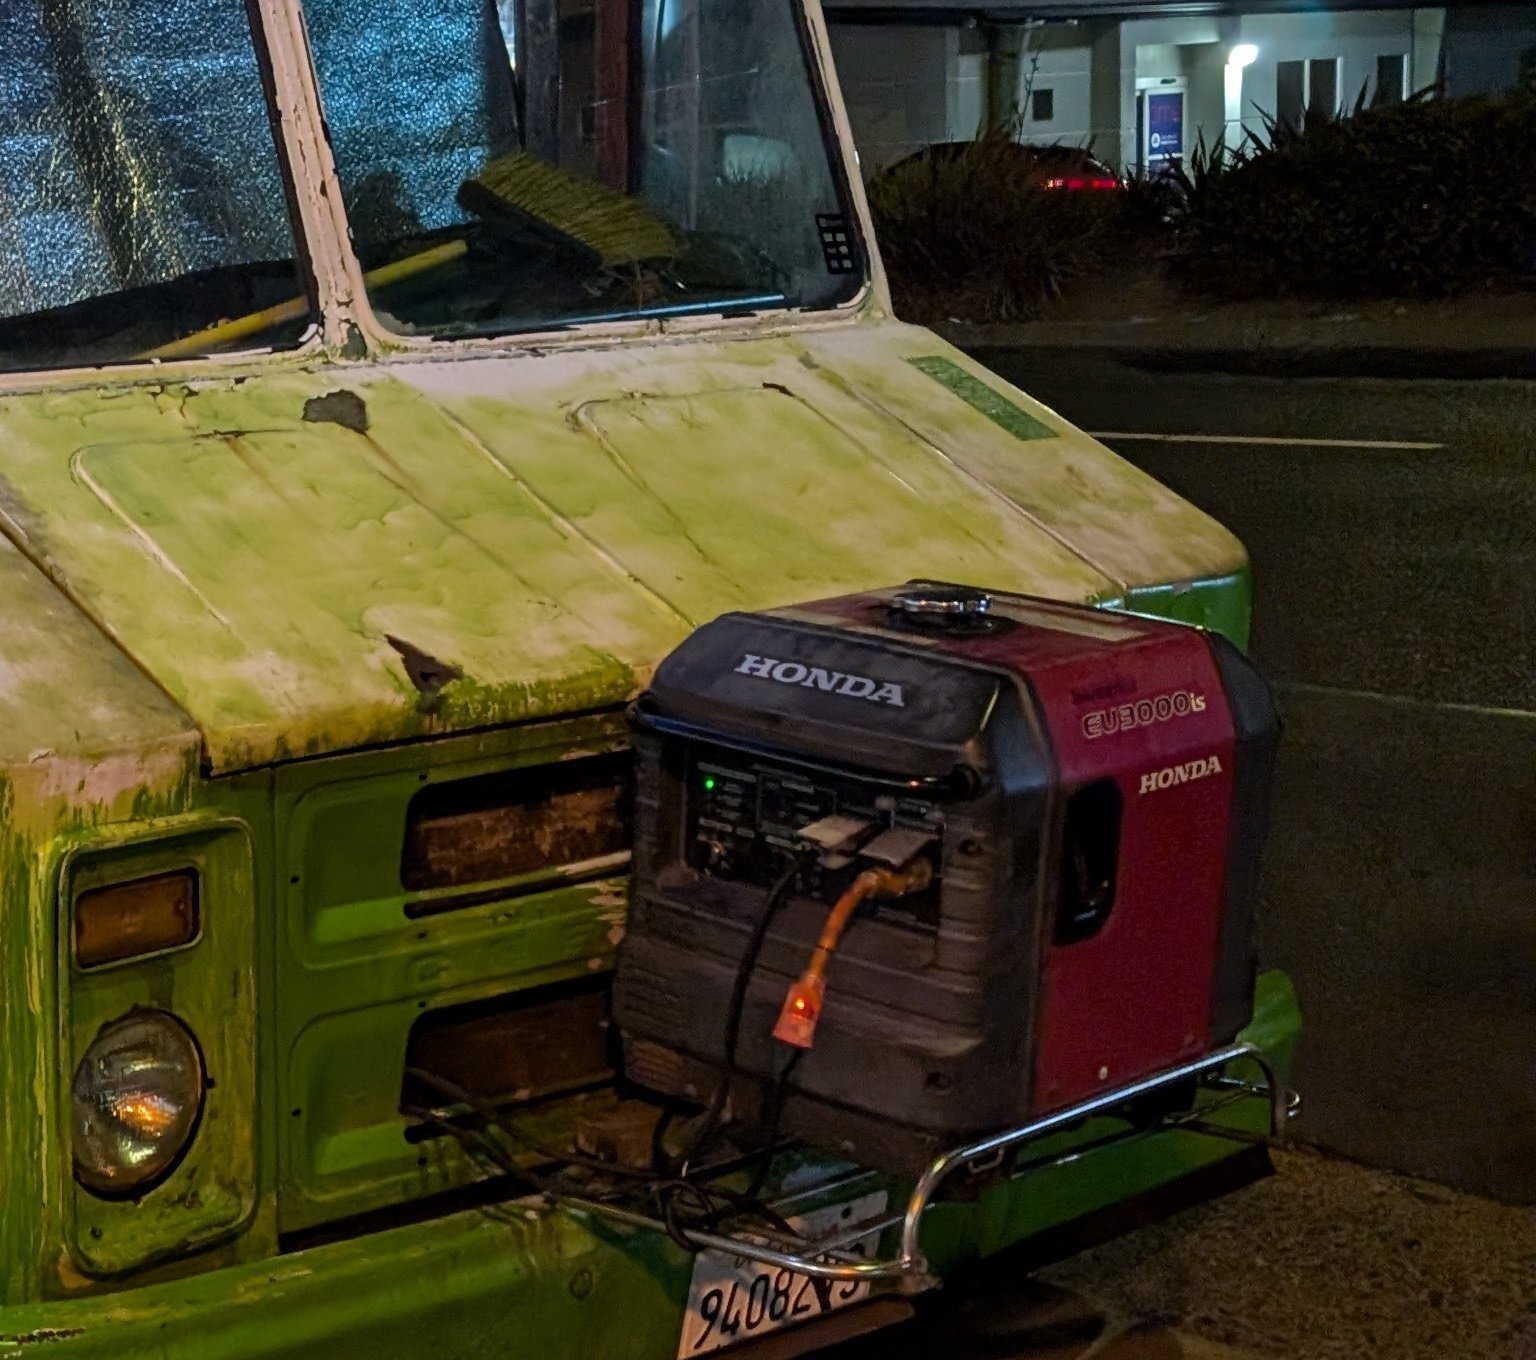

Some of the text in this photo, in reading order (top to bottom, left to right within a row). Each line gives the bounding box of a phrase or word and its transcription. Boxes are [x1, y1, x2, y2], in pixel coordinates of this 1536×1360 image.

[733, 653, 905, 708] HONDA
[1081, 690, 1207, 740] EU3000is
[1138, 755, 1224, 794] HONDA
